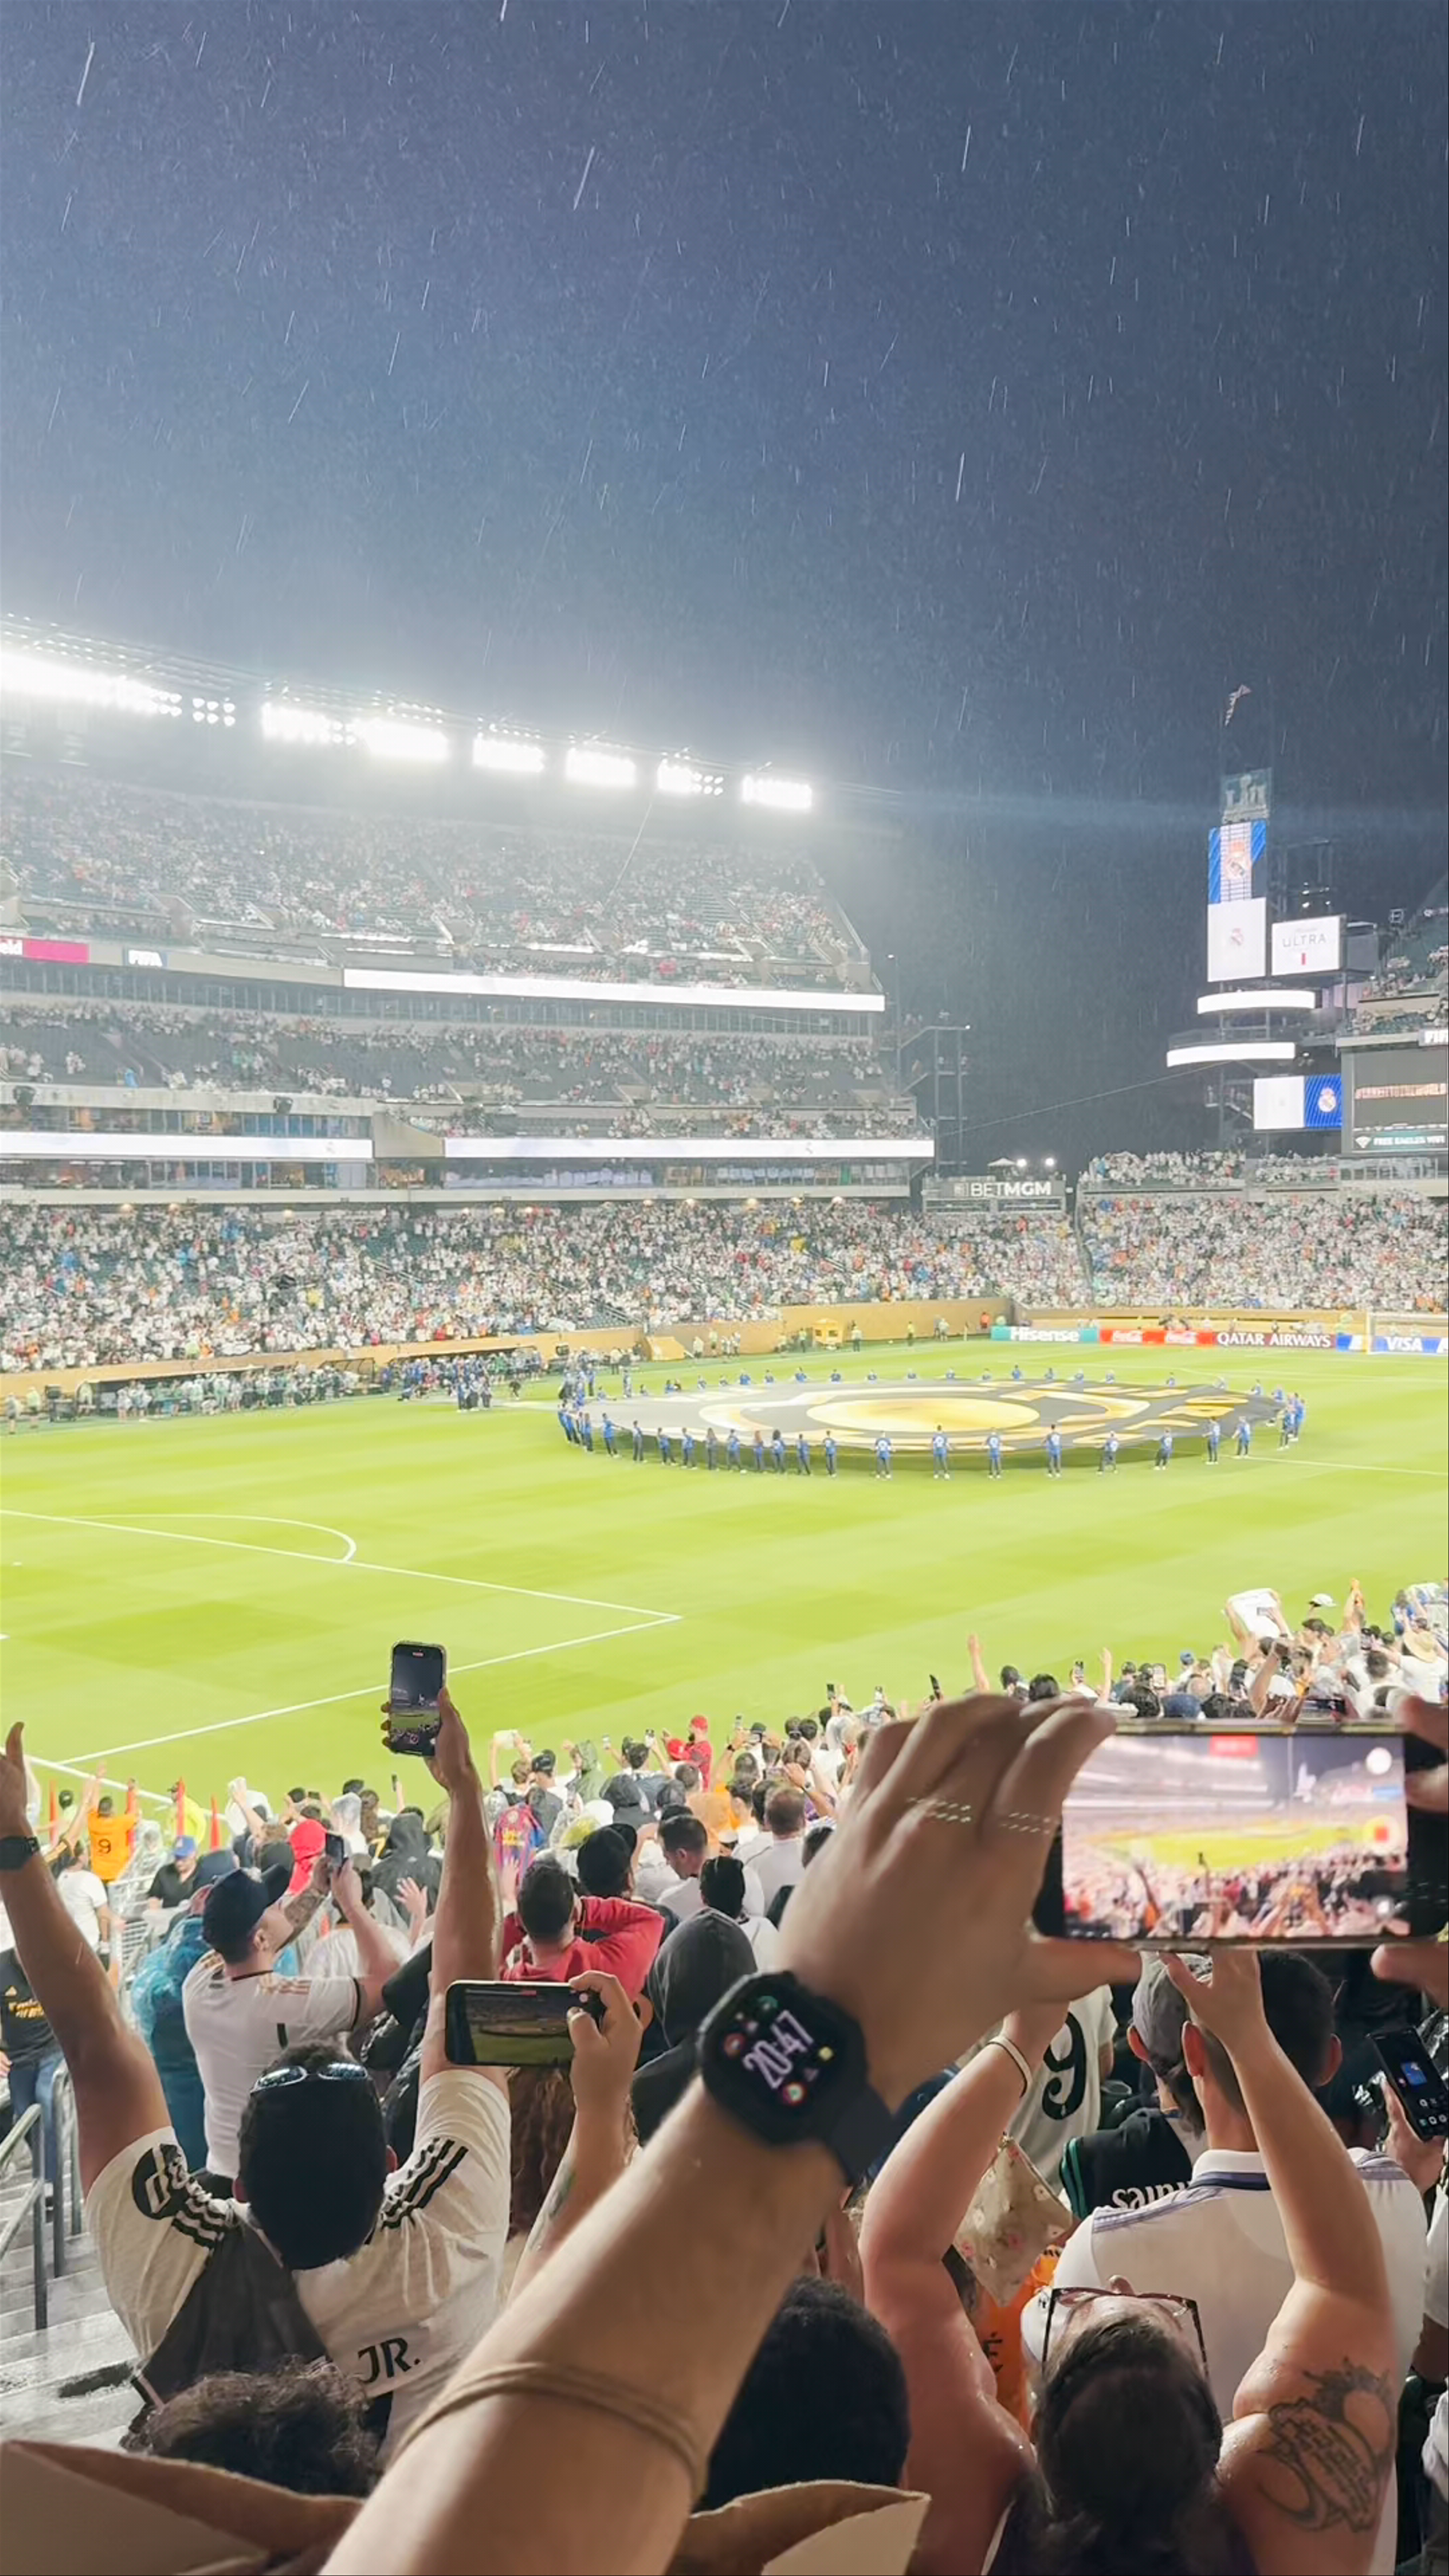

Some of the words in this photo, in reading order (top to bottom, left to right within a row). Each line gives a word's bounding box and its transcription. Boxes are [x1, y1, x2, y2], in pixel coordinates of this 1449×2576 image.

[1282, 934, 1326, 947] ULTRA
[971, 1181, 1051, 1196] BETMGM
[1010, 1326, 1080, 1342] Hisense
[1217, 1332, 1264, 1346] QATAR
[1269, 1333, 1331, 1347] AIRWAYS
[1385, 1336, 1423, 1352] VISA
[98, 1839, 111, 1854] 9
[357, 2338, 421, 2384] JR.
